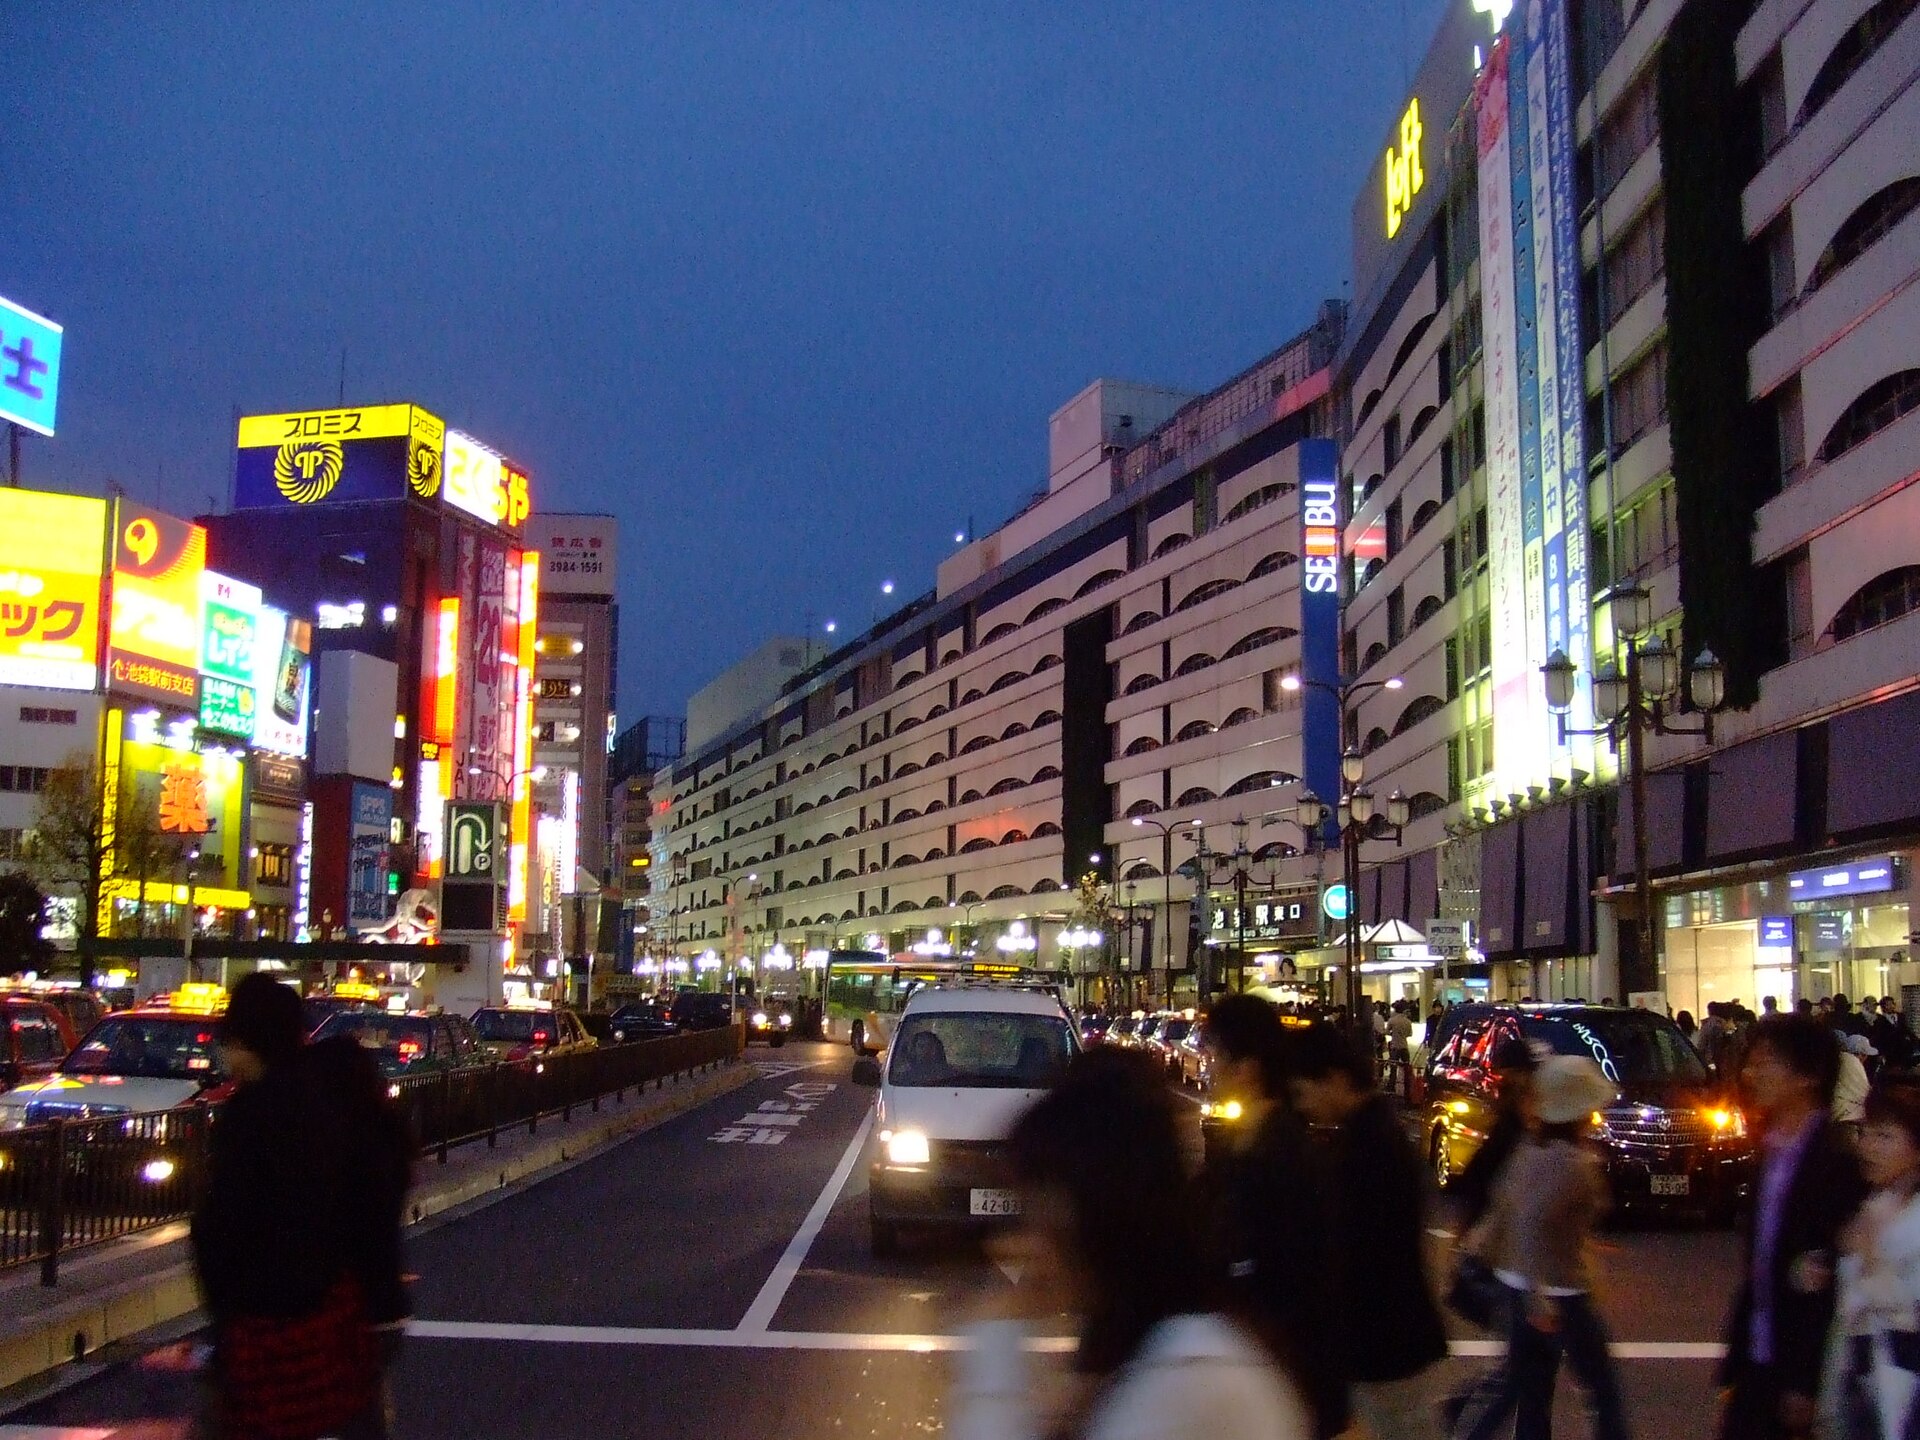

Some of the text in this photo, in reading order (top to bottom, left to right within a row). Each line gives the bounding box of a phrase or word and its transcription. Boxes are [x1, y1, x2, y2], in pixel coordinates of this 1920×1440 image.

[0, 330, 48, 400] 士
[284, 412, 361, 438] プロミス
[413, 414, 443, 440] プロミス
[1305, 483, 1337, 593] SEIBU
[125, 660, 195, 696] 池袋駅前支店
[159, 763, 208, 833] 薬
